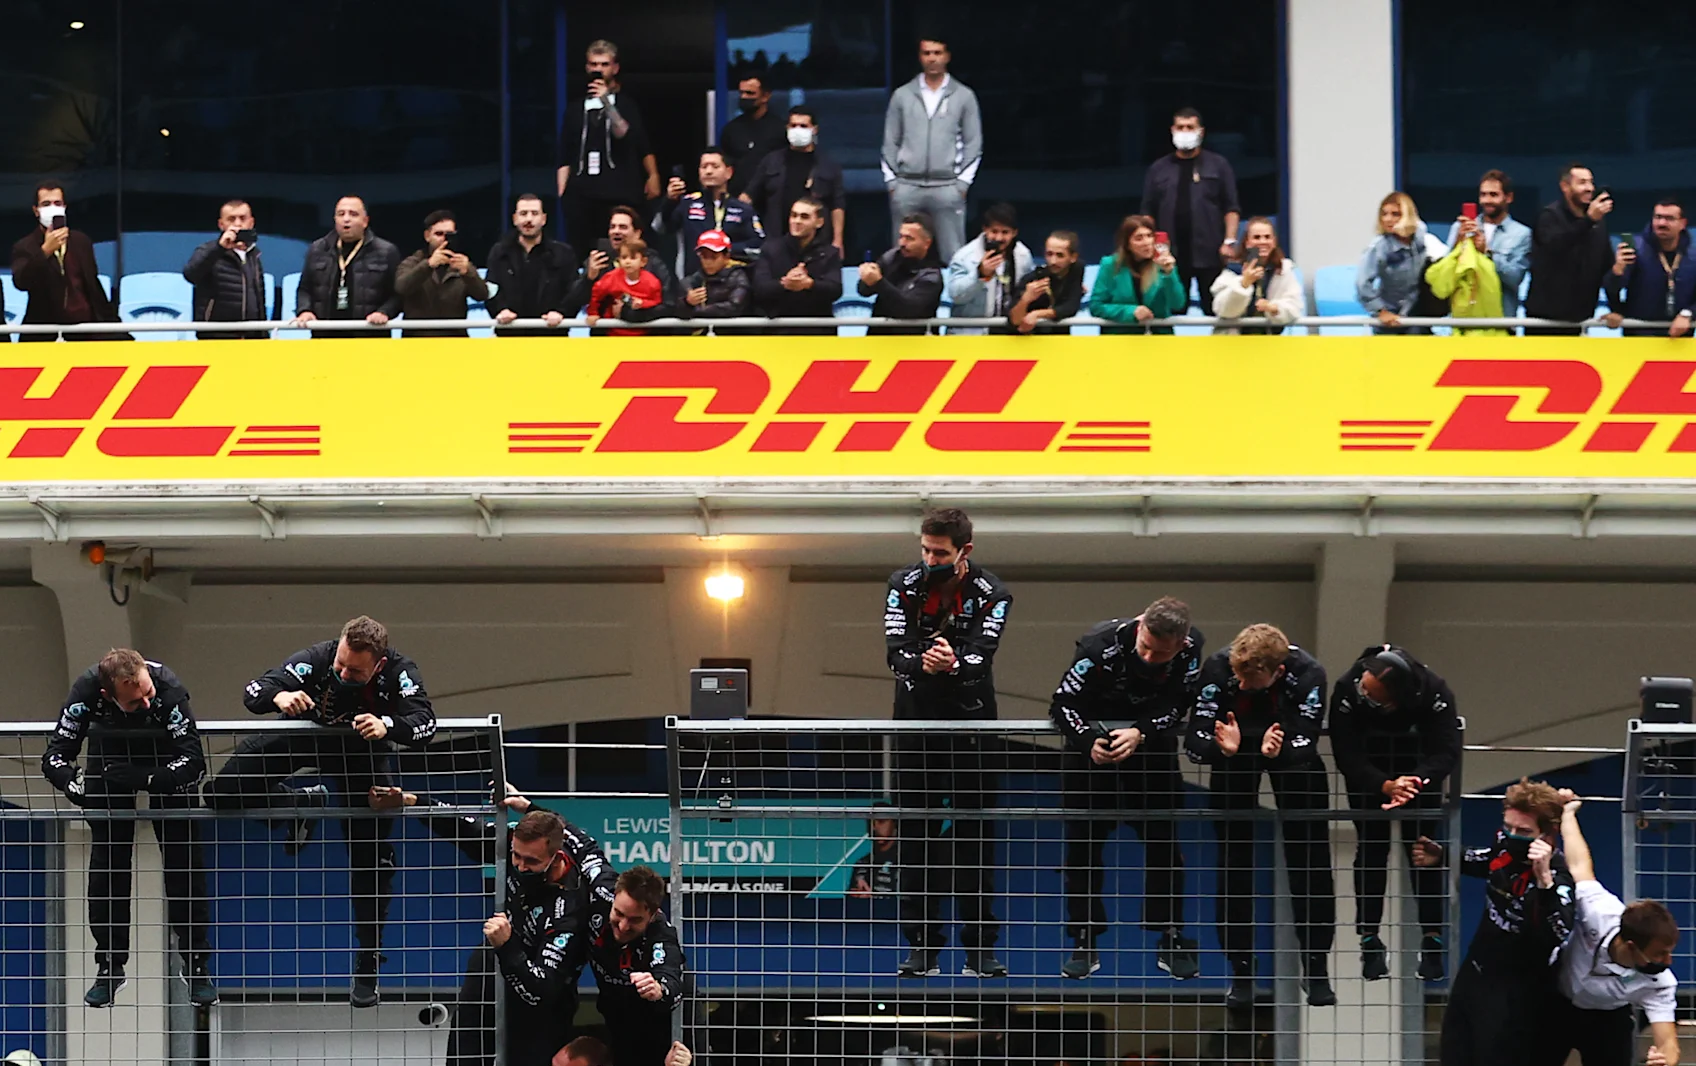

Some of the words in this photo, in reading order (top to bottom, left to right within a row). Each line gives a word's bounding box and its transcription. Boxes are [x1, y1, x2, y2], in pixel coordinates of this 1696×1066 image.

[595, 360, 1064, 452] DHL
[1429, 360, 1696, 451] DH
[604, 818, 671, 834] LEWIS
[604, 841, 775, 863] HAMILTON
